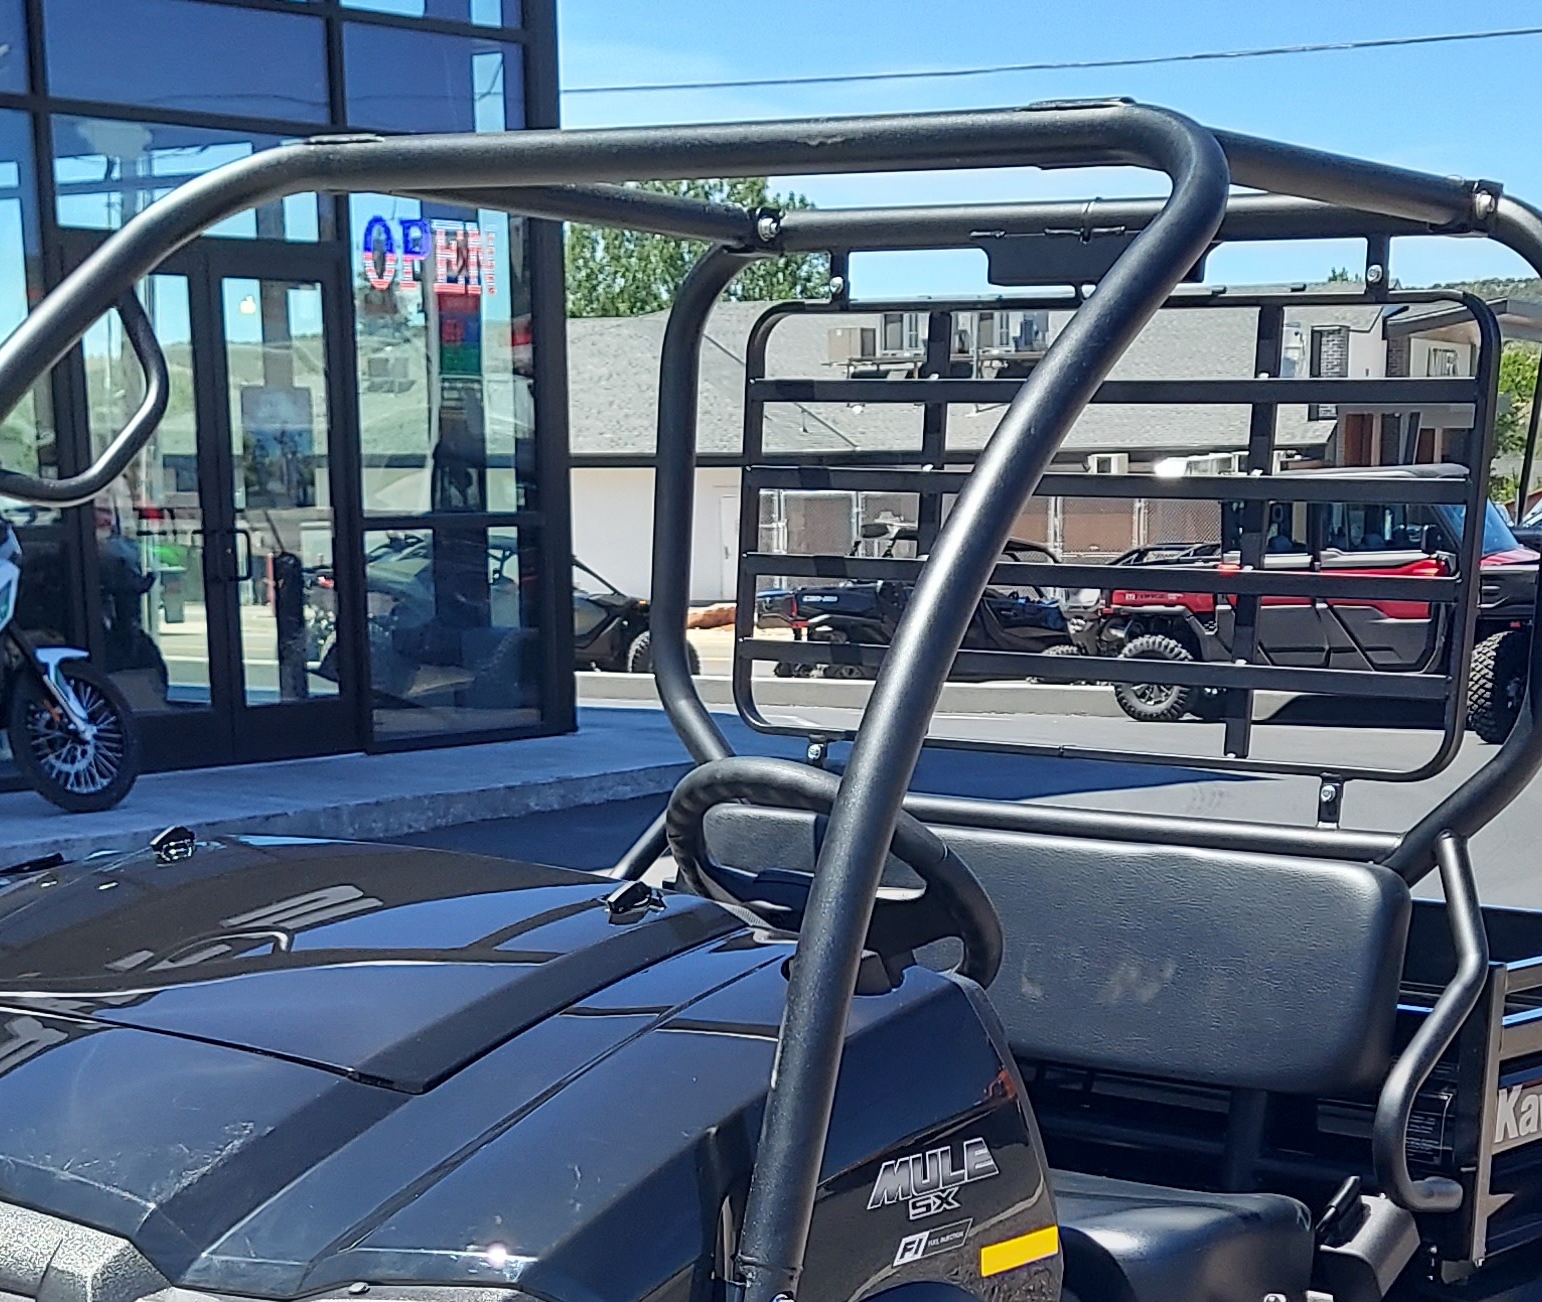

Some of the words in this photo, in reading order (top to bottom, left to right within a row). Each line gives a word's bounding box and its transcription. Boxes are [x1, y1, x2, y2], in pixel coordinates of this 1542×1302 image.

[363, 216, 496, 295] OPEN
[867, 1137, 1000, 1210] MULE
[909, 1187, 961, 1220] SX
